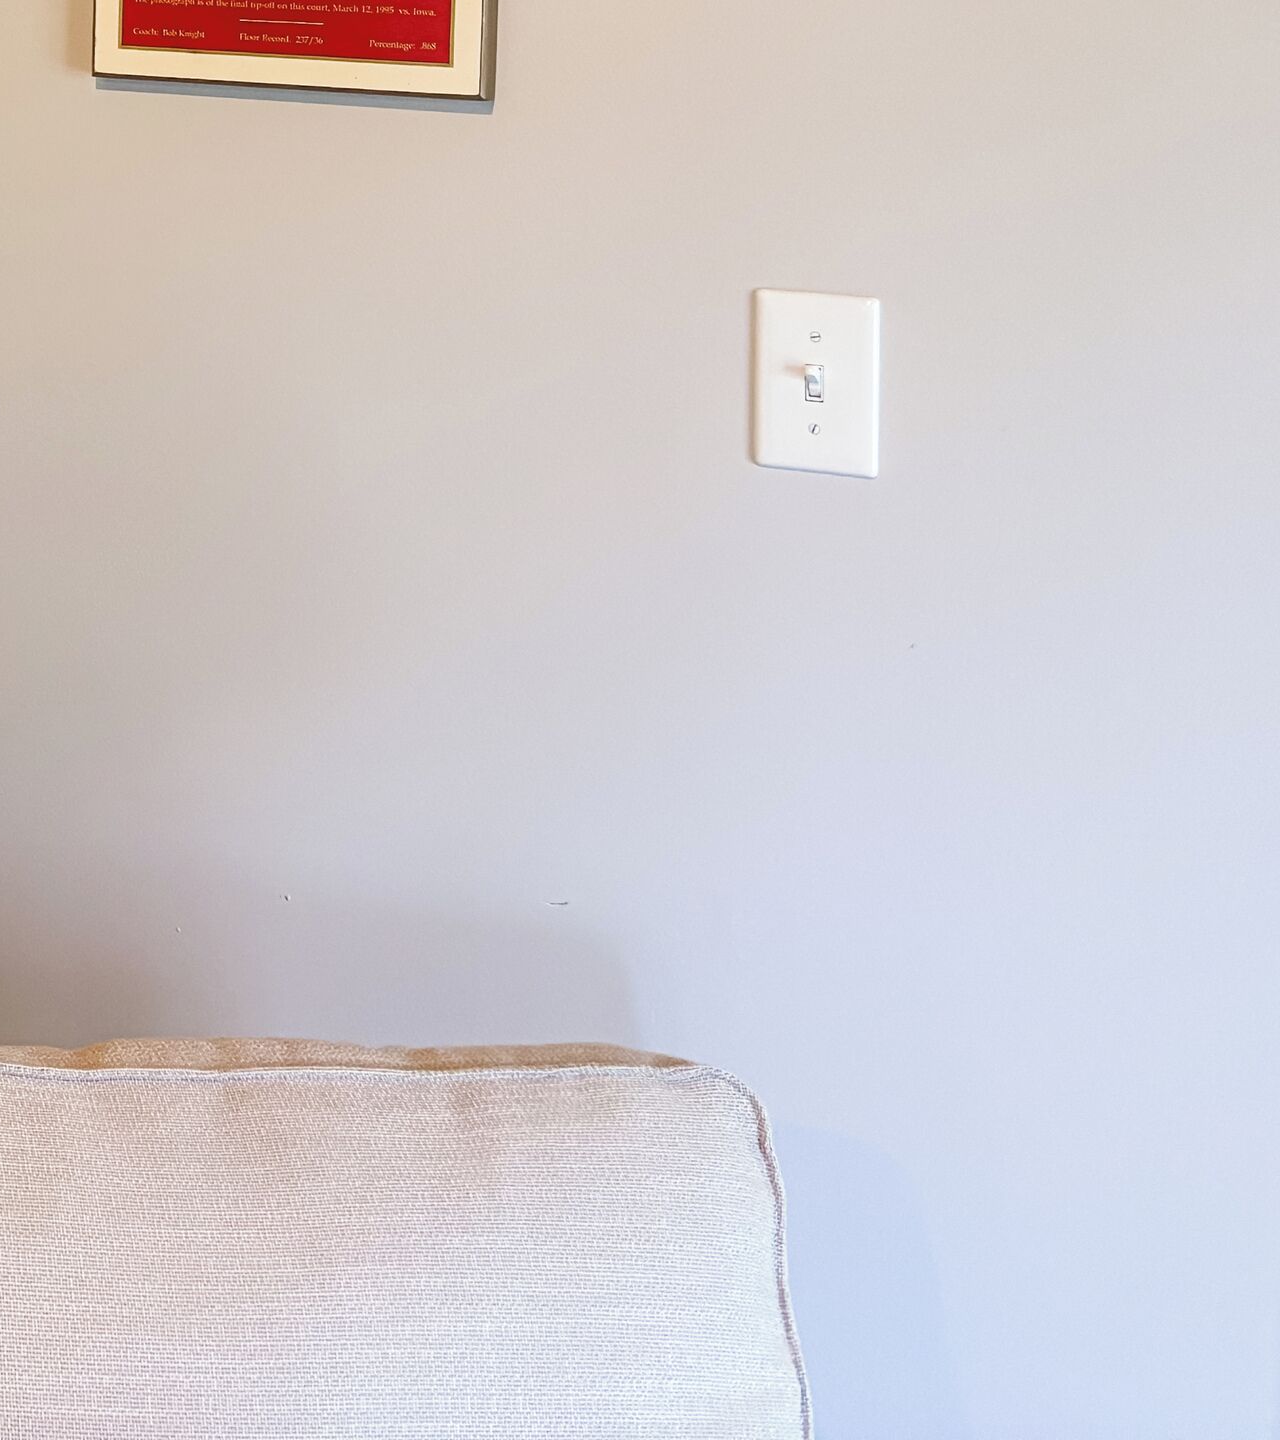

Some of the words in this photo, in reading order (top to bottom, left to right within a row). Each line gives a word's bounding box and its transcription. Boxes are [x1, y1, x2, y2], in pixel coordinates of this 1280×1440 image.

[231, 0, 248, 8] final
[333, 4, 358, 12] March
[133, 28, 158, 36] Coach:
[179, 30, 205, 38] Knight
[370, 40, 415, 51] Percentage:
